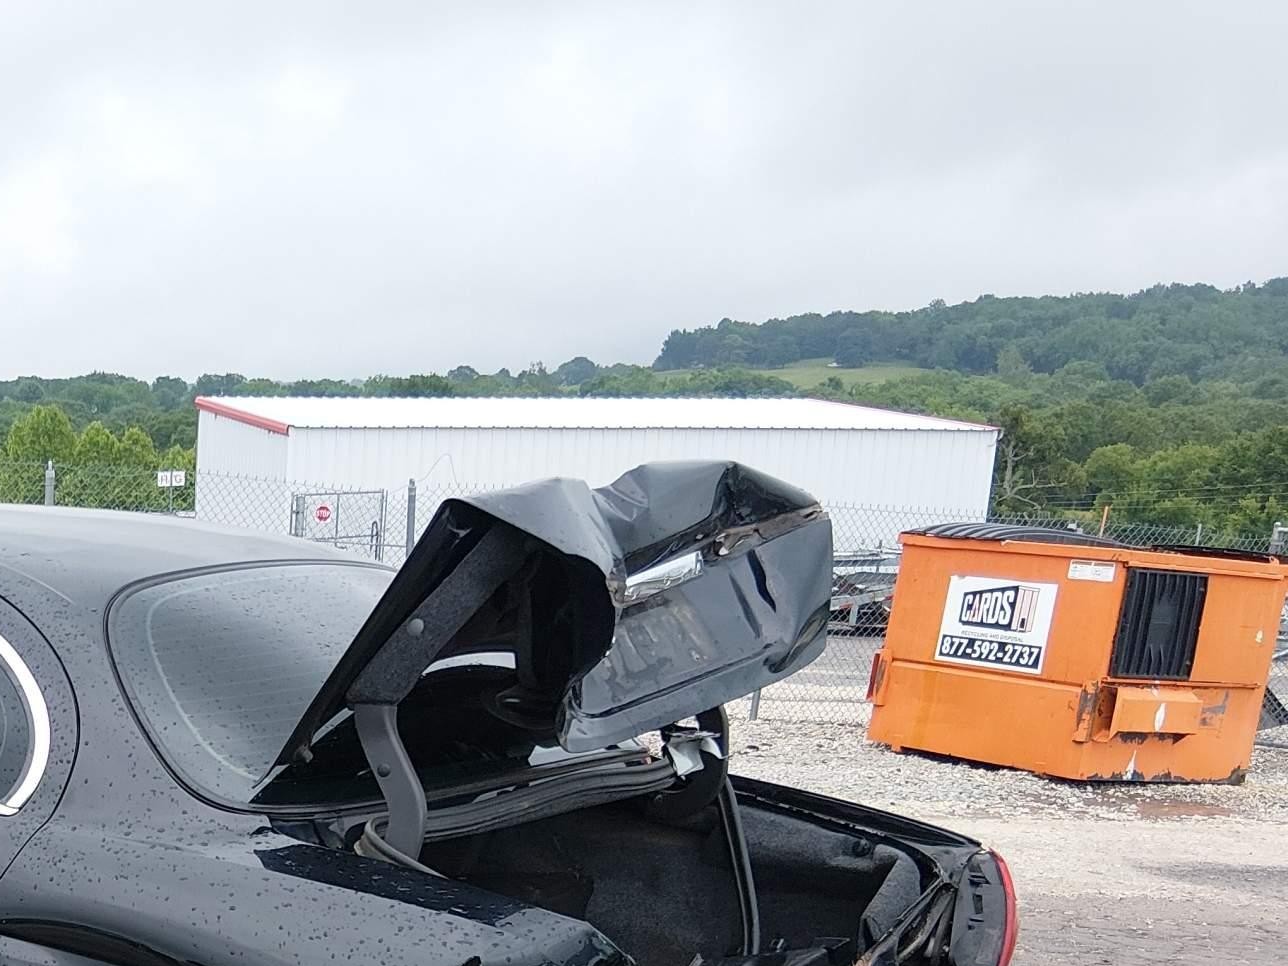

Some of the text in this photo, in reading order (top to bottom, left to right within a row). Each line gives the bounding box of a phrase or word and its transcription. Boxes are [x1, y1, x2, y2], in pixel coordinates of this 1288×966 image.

[961, 590, 1015, 625] CARDS
[941, 636, 1040, 666] 877-592-2737
[961, 630, 988, 639] RECYCLING
[1000, 634, 1024, 642] DISPOSAL
